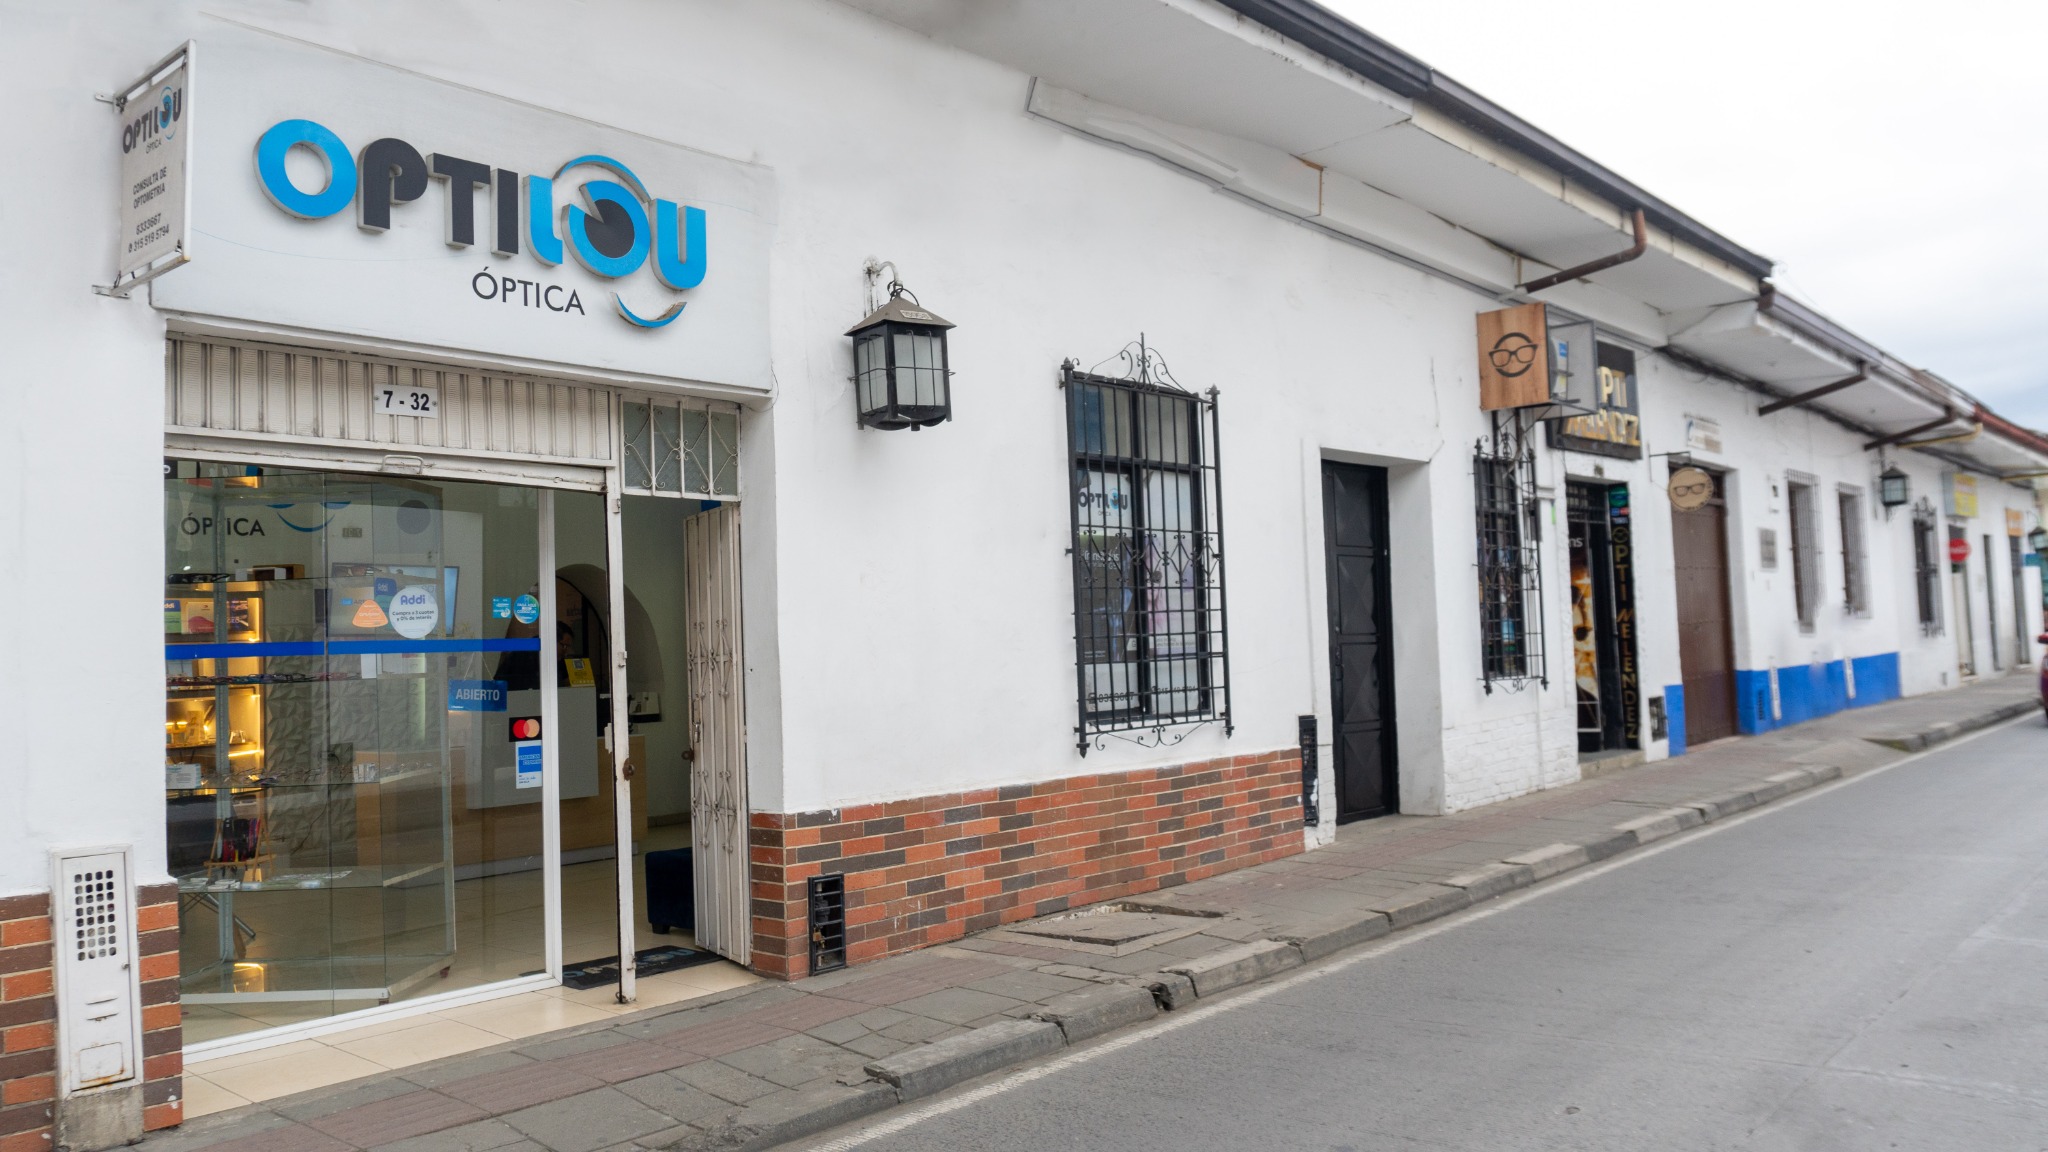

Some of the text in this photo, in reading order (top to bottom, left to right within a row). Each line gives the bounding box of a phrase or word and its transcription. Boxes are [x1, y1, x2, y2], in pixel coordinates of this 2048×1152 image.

[122, 87, 182, 154] OPTILOU
[133, 166, 167, 196] CONSULTA DE
[253, 118, 706, 291] OPTILOU
[471, 266, 586, 316] ÓPTICA
[383, 390, 394, 409] 7
[410, 392, 430, 412] 32
[181, 512, 266, 537] ÓPICA
[400, 594, 426, 606] Addi
[455, 688, 500, 701] ABIERTO
